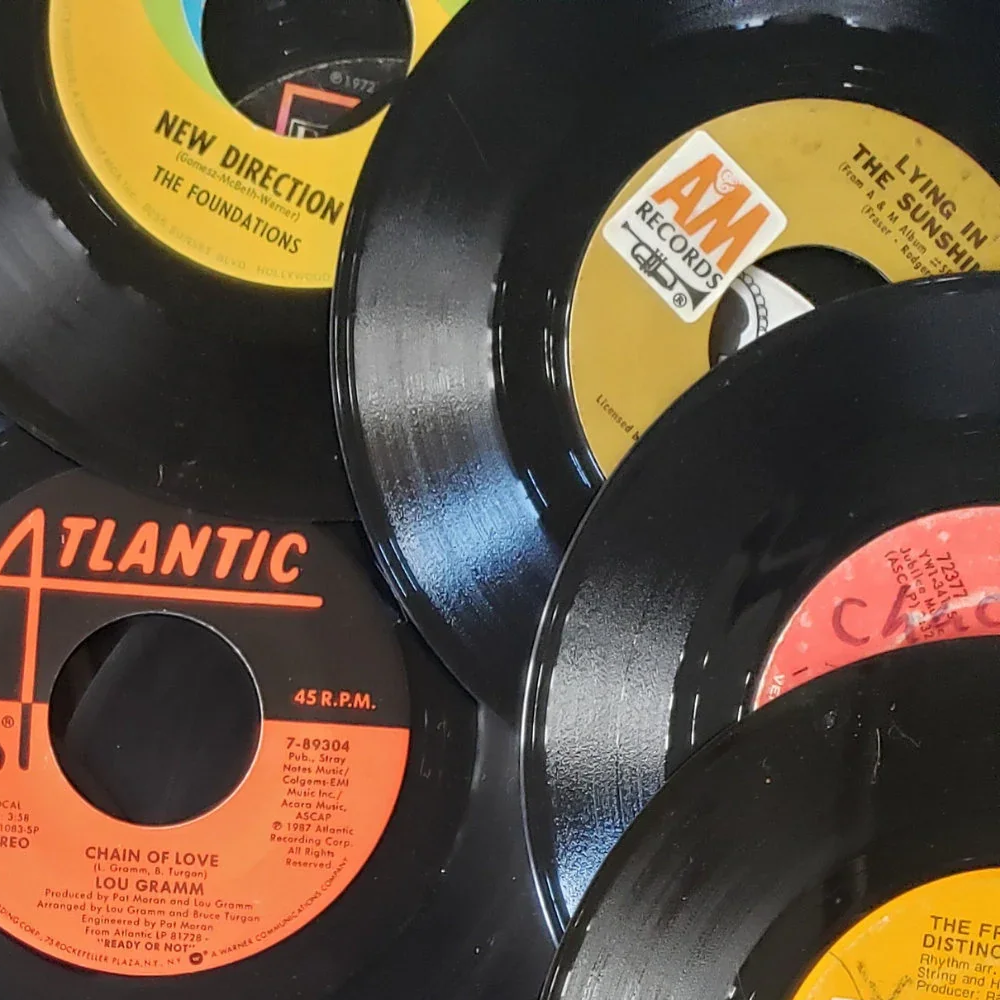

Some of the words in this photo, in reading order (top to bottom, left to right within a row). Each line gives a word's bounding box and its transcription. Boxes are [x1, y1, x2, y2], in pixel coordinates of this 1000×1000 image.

[154, 109, 217, 156] NEW
[220, 145, 345, 225] DIRECTION
[852, 142, 895, 191] THE
[152, 165, 184, 193] THE
[186, 184, 302, 254] FOUNDATIONS
[838, 161, 864, 189] (From
[866, 189, 875, 199] A
[887, 211, 899, 224] M
[899, 225, 927, 254] Album
[894, 154, 956, 220] LYING
[960, 220, 988, 250] IN
[635, 200, 725, 290] RECORDS
[596, 394, 634, 432] Licensed
[936, 552, 968, 598] 72377
[293, 688, 317, 705] 45
[320, 691, 376, 710] R.P.M.
[286, 737, 351, 752] 7-89304
[283, 764, 312, 774] Notes
[319, 753, 346, 766] Stray
[286, 788, 316, 798] Music
[7, 813, 30, 823] 3:58
[295, 812, 332, 822] ASCAP
[286, 823, 311, 832] 1987
[315, 825, 354, 836] Atlantic
[270, 834, 321, 846] Recording
[85, 846, 140, 862] CHAIN
[146, 850, 169, 864] OF
[175, 851, 219, 868] LOVE
[287, 846, 301, 855] All
[304, 848, 335, 859] Rights
[109, 864, 151, 877] Gramm,
[154, 867, 164, 876] B.
[286, 858, 332, 869] Reserved
[95, 876, 129, 891] LOU
[135, 879, 205, 896] GRAMM
[45, 888, 93, 900] Produced
[96, 891, 110, 903] by
[113, 893, 129, 903] Pat
[133, 894, 169, 905] Moran
[170, 897, 189, 907] and
[194, 898, 211, 909] Lou
[214, 899, 254, 910] Gramm
[220, 938, 253, 956] WARNER
[255, 890, 322, 942] COMMUNICATIONS
[320, 857, 348, 892] COMPANY
[37, 900, 87, 913] Arranged
[90, 902, 103, 914] by
[106, 904, 123, 914] Lou
[127, 906, 166, 917] Gramm
[169, 908, 189, 918] and
[193, 910, 220, 920] Bruce
[81, 914, 140, 927] Engineered
[144, 917, 157, 930] by
[160, 919, 177, 929] Pat
[180, 920, 214, 931] Moran
[930, 915, 972, 935] THE
[85, 926, 110, 937] From
[114, 928, 152, 939] Atlantic
[156, 930, 167, 939] LP
[170, 931, 202, 942] 81728
[54, 940, 108, 964] ROCKEFELLER
[144, 941, 160, 951] OR
[920, 952, 970, 970] Rhythm
[974, 962, 997, 975] arr.
[917, 966, 957, 985] String
[963, 975, 985, 987] and
[916, 979, 980, 1000] Producer:
